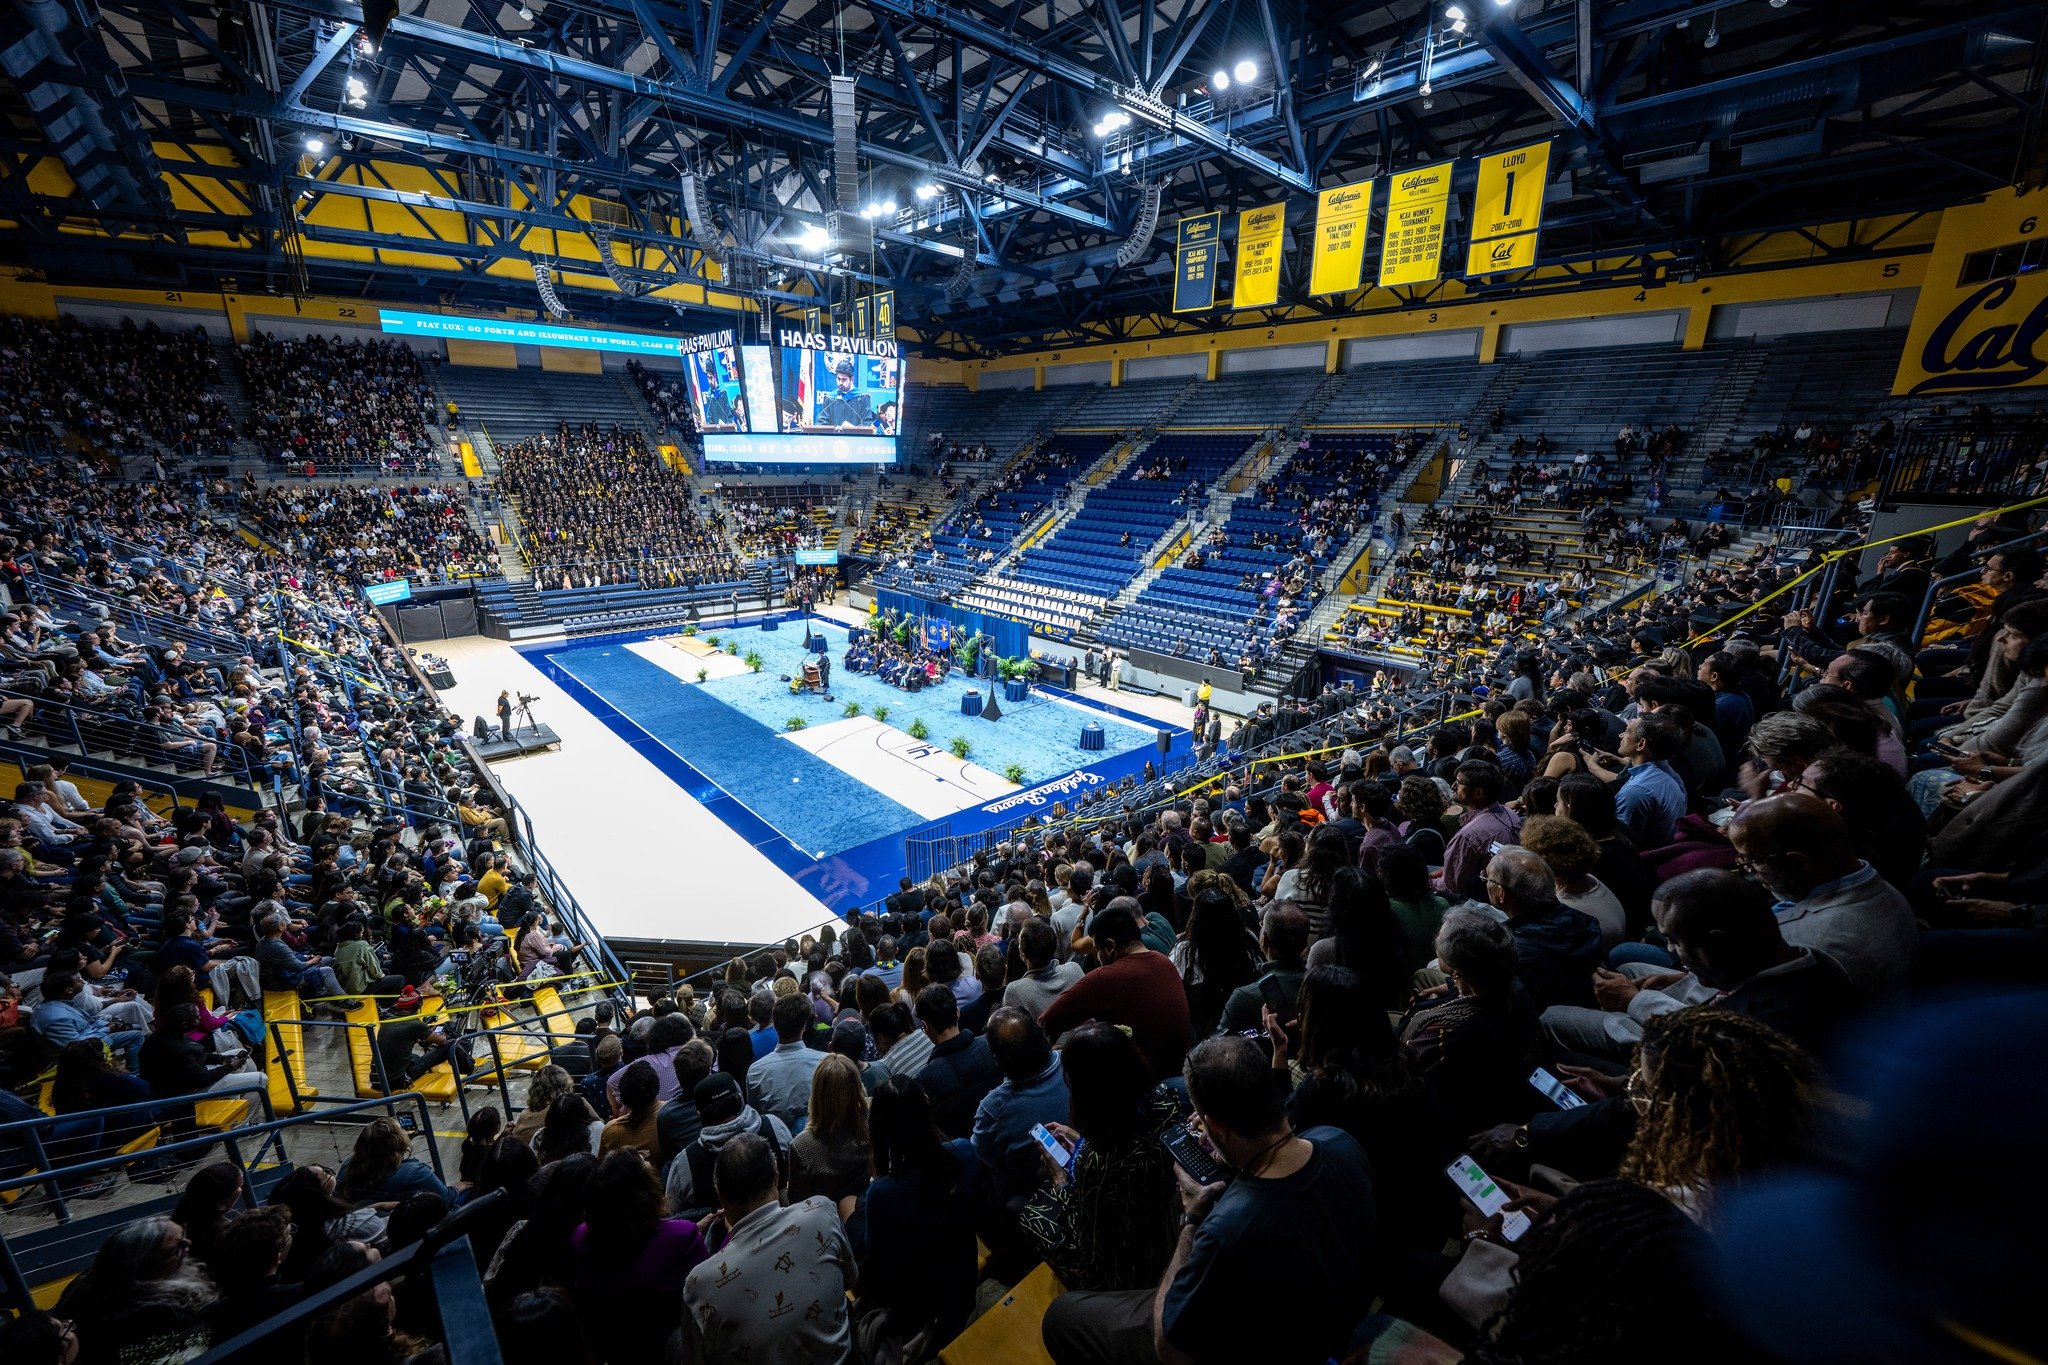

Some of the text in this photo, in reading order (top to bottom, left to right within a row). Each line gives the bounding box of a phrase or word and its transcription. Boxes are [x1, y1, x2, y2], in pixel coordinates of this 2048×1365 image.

[1502, 152, 1526, 168] LLOYD
[1401, 174, 1439, 190] California
[1328, 190, 1360, 206] California
[1409, 188, 1430, 196] VOLLEYBALL
[1504, 171, 1516, 216] 1
[1248, 212, 1276, 226] California
[1400, 207, 1433, 220] NCAA WOMEN'S
[1326, 222, 1356, 233] NCAA WOMEN'S
[1401, 216, 1430, 228] TOURNAMENT
[1491, 218, 1522, 232] 2007-2010
[2018, 216, 2038, 234] 6
[1329, 230, 1351, 240] FINAL FOUR
[1389, 224, 1440, 240] 1982 1983 1987 1988
[1257, 241, 1272, 249] WOMEN'S
[1327, 241, 1351, 252] 2007 2010
[1388, 233, 1440, 248] 1989 2002 2003 2004
[1386, 242, 1438, 257] 2005 2006 2007 2008
[1491, 242, 1515, 262] Cal
[1386, 251, 1437, 266] 2009 2010 2011 2012
[1490, 260, 1512, 268] VOLLEYBALL
[1882, 263, 1900, 278] 5
[165, 292, 182, 302] 21
[1634, 291, 1646, 302] 4
[338, 308, 357, 318] 22
[879, 304, 890, 326] 40
[1428, 313, 1438, 322] 3
[484, 327, 514, 335] FORTH
[539, 331, 589, 342] ILLUMINATE
[610, 339, 639, 347] WORLD,
[680, 329, 732, 354] HAAS PAVILION
[1267, 331, 1274, 339] 2
[780, 329, 898, 357] HAAS PAVILION
[758, 444, 776, 453] OF
[785, 443, 824, 456] 2025!
[1041, 770, 1105, 794] Golden
[982, 791, 1046, 814] Bears
